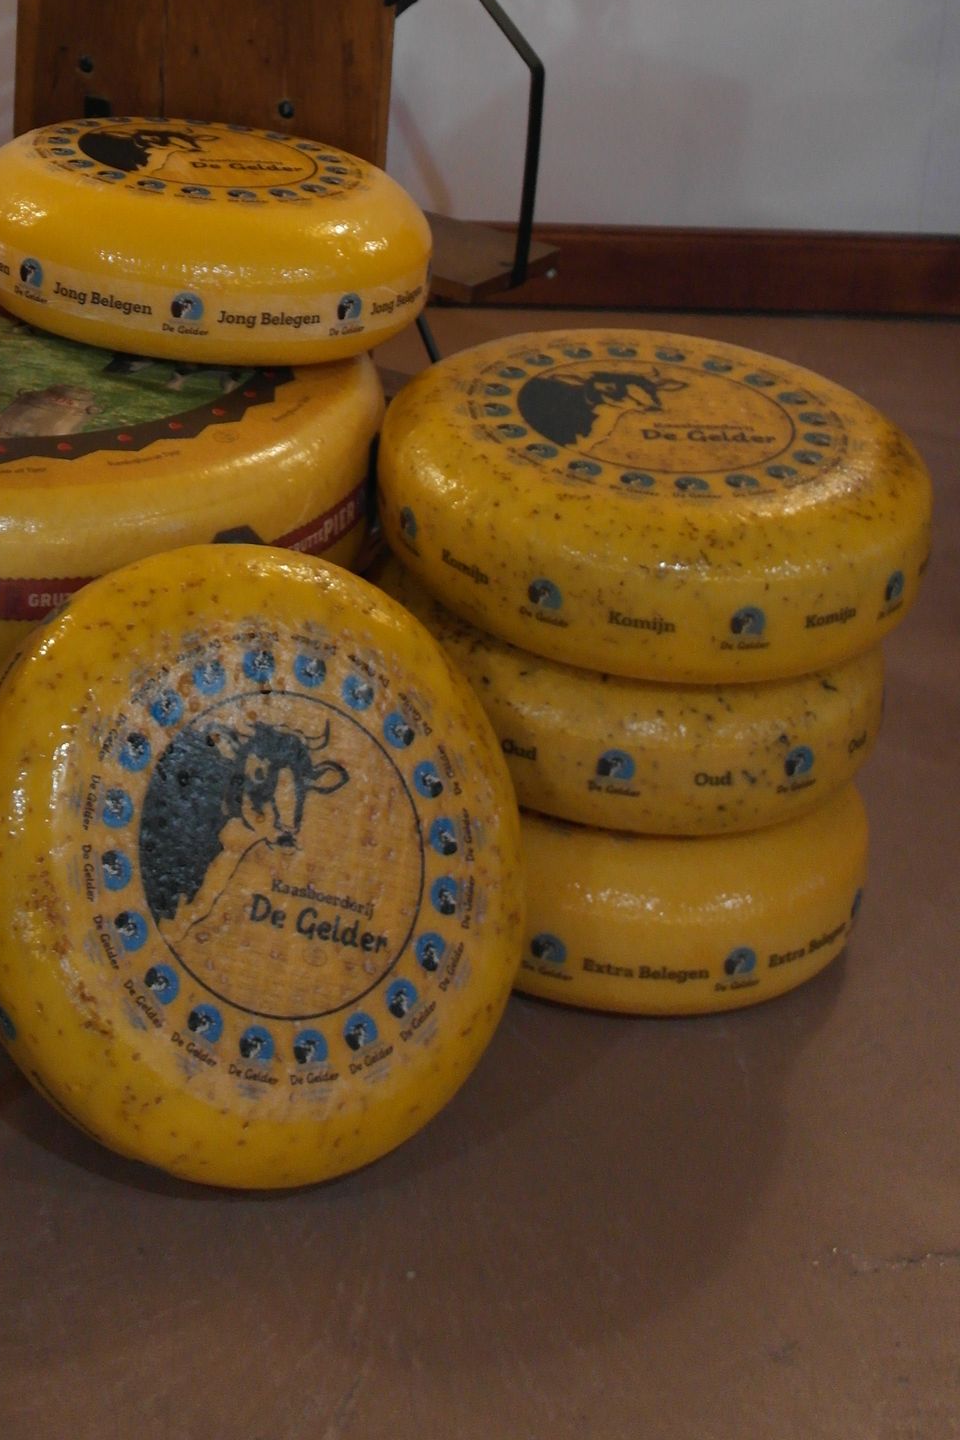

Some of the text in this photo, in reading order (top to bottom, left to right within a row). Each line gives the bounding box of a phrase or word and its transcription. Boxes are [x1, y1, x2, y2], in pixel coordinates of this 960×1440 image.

[52, 281, 152, 315] Jong Belegen
[370, 302, 394, 315] Jong
[217, 311, 321, 328] Jong Belegen
[641, 429, 775, 444] De Gelder
[442, 548, 489, 585] Komijn
[608, 611, 675, 634] Komijn
[804, 606, 857, 629] Komijn
[501, 738, 537, 761] Oud
[694, 770, 732, 786] Oud
[93, 914, 104, 931] De
[249, 893, 389, 954] De Gelder
[768, 948, 806, 968] Extra
[583, 957, 710, 984] Extra Belegen
[123, 979, 137, 996] De
[171, 1031, 217, 1067] De Gelder
[228, 1063, 242, 1078] De
[348, 1062, 363, 1075] De
[290, 1073, 303, 1086] De
